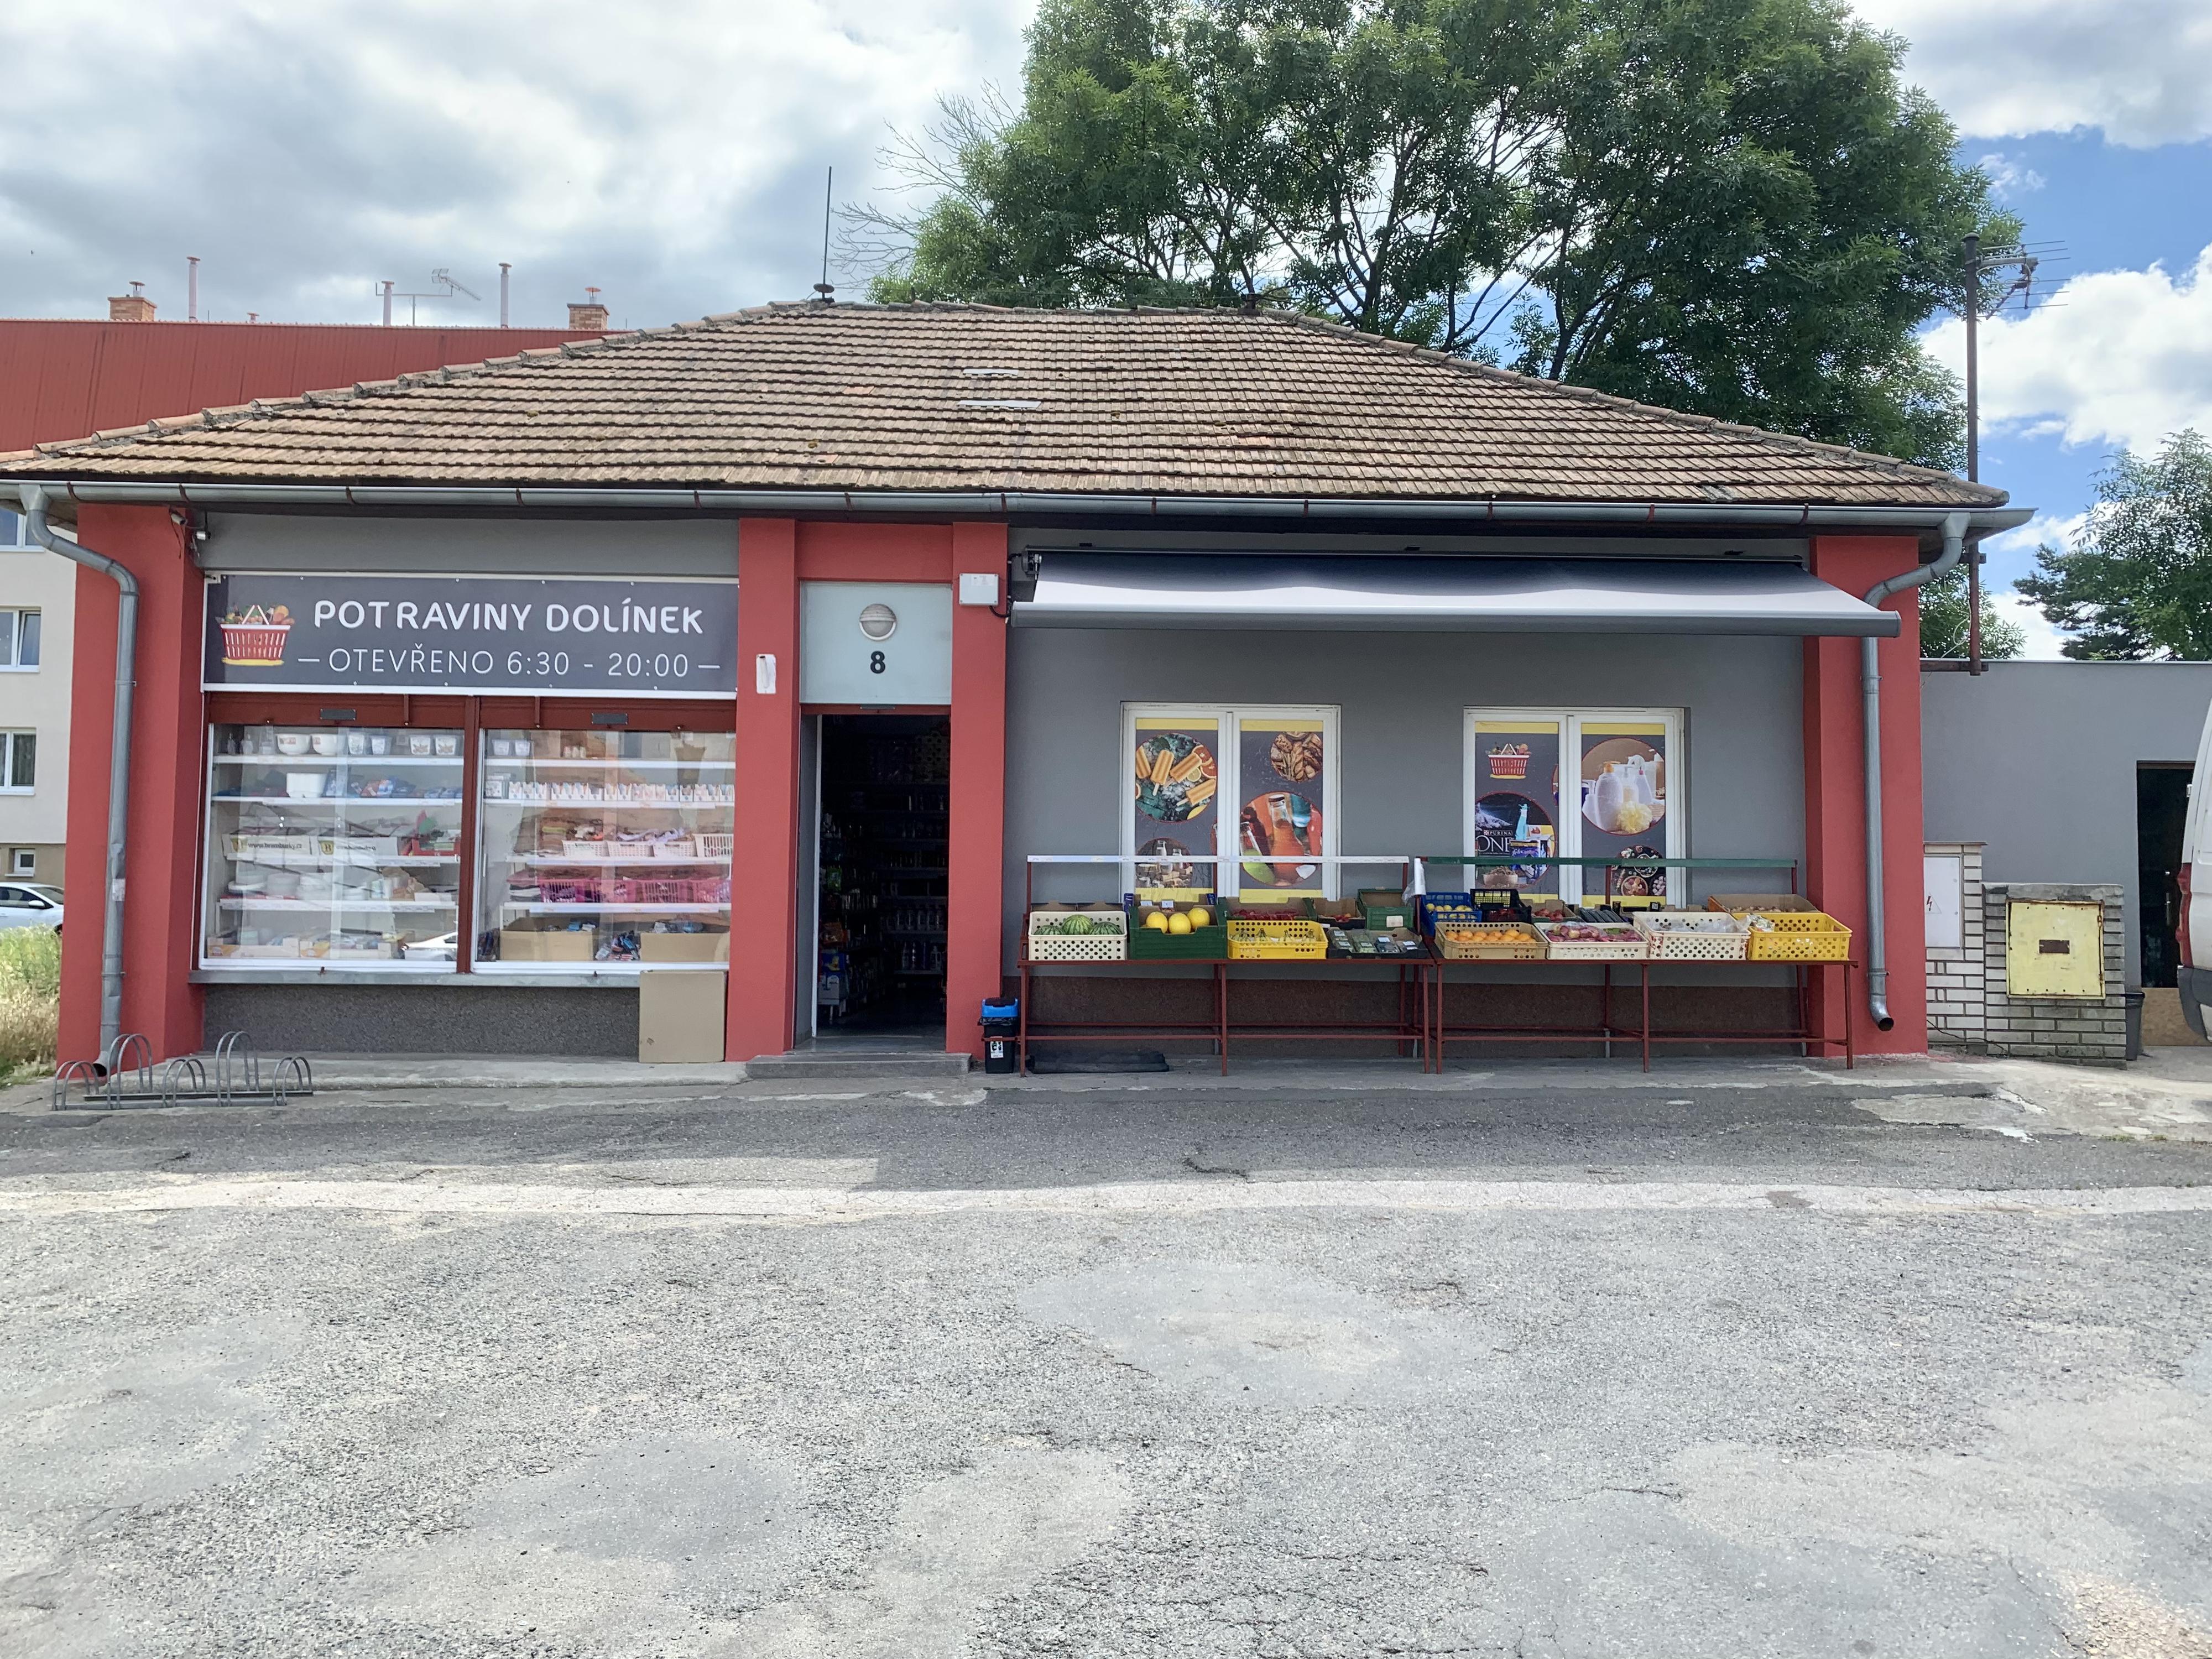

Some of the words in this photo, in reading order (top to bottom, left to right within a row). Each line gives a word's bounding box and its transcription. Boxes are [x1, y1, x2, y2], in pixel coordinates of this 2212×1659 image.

[314, 600, 532, 632] POTRAVINY
[546, 597, 703, 635] DOLÍNEK
[329, 643, 493, 674] OTEVŘENO
[507, 651, 569, 675] 6:30
[608, 653, 688, 677] 20:00
[870, 650, 886, 674] 8
